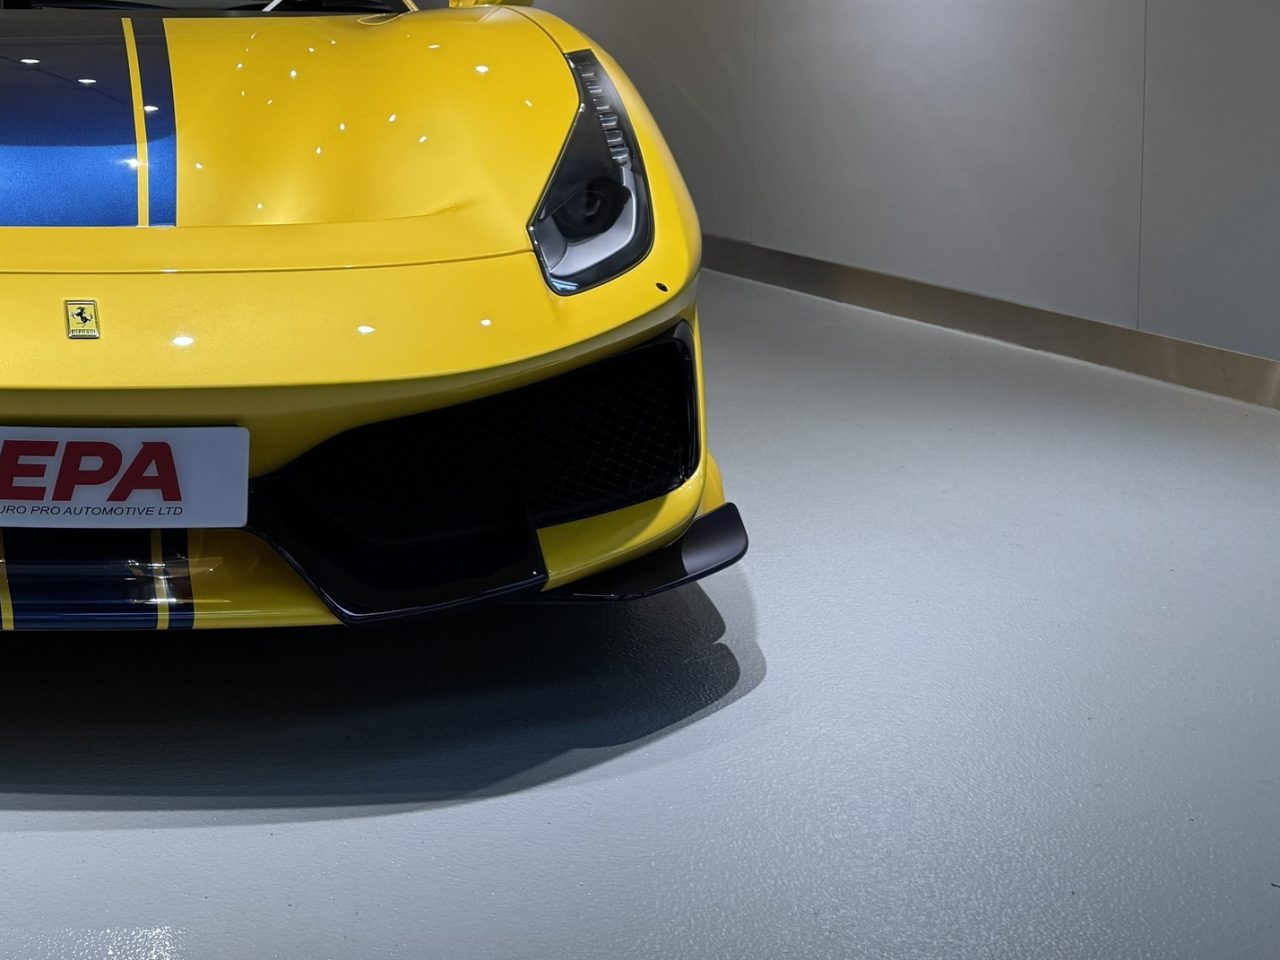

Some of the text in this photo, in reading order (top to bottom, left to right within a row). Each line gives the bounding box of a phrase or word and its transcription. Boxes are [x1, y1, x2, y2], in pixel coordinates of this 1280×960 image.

[30, 505, 61, 516] PRO
[63, 505, 156, 516] AUTOMOTIVE
[158, 506, 182, 516] LTD
